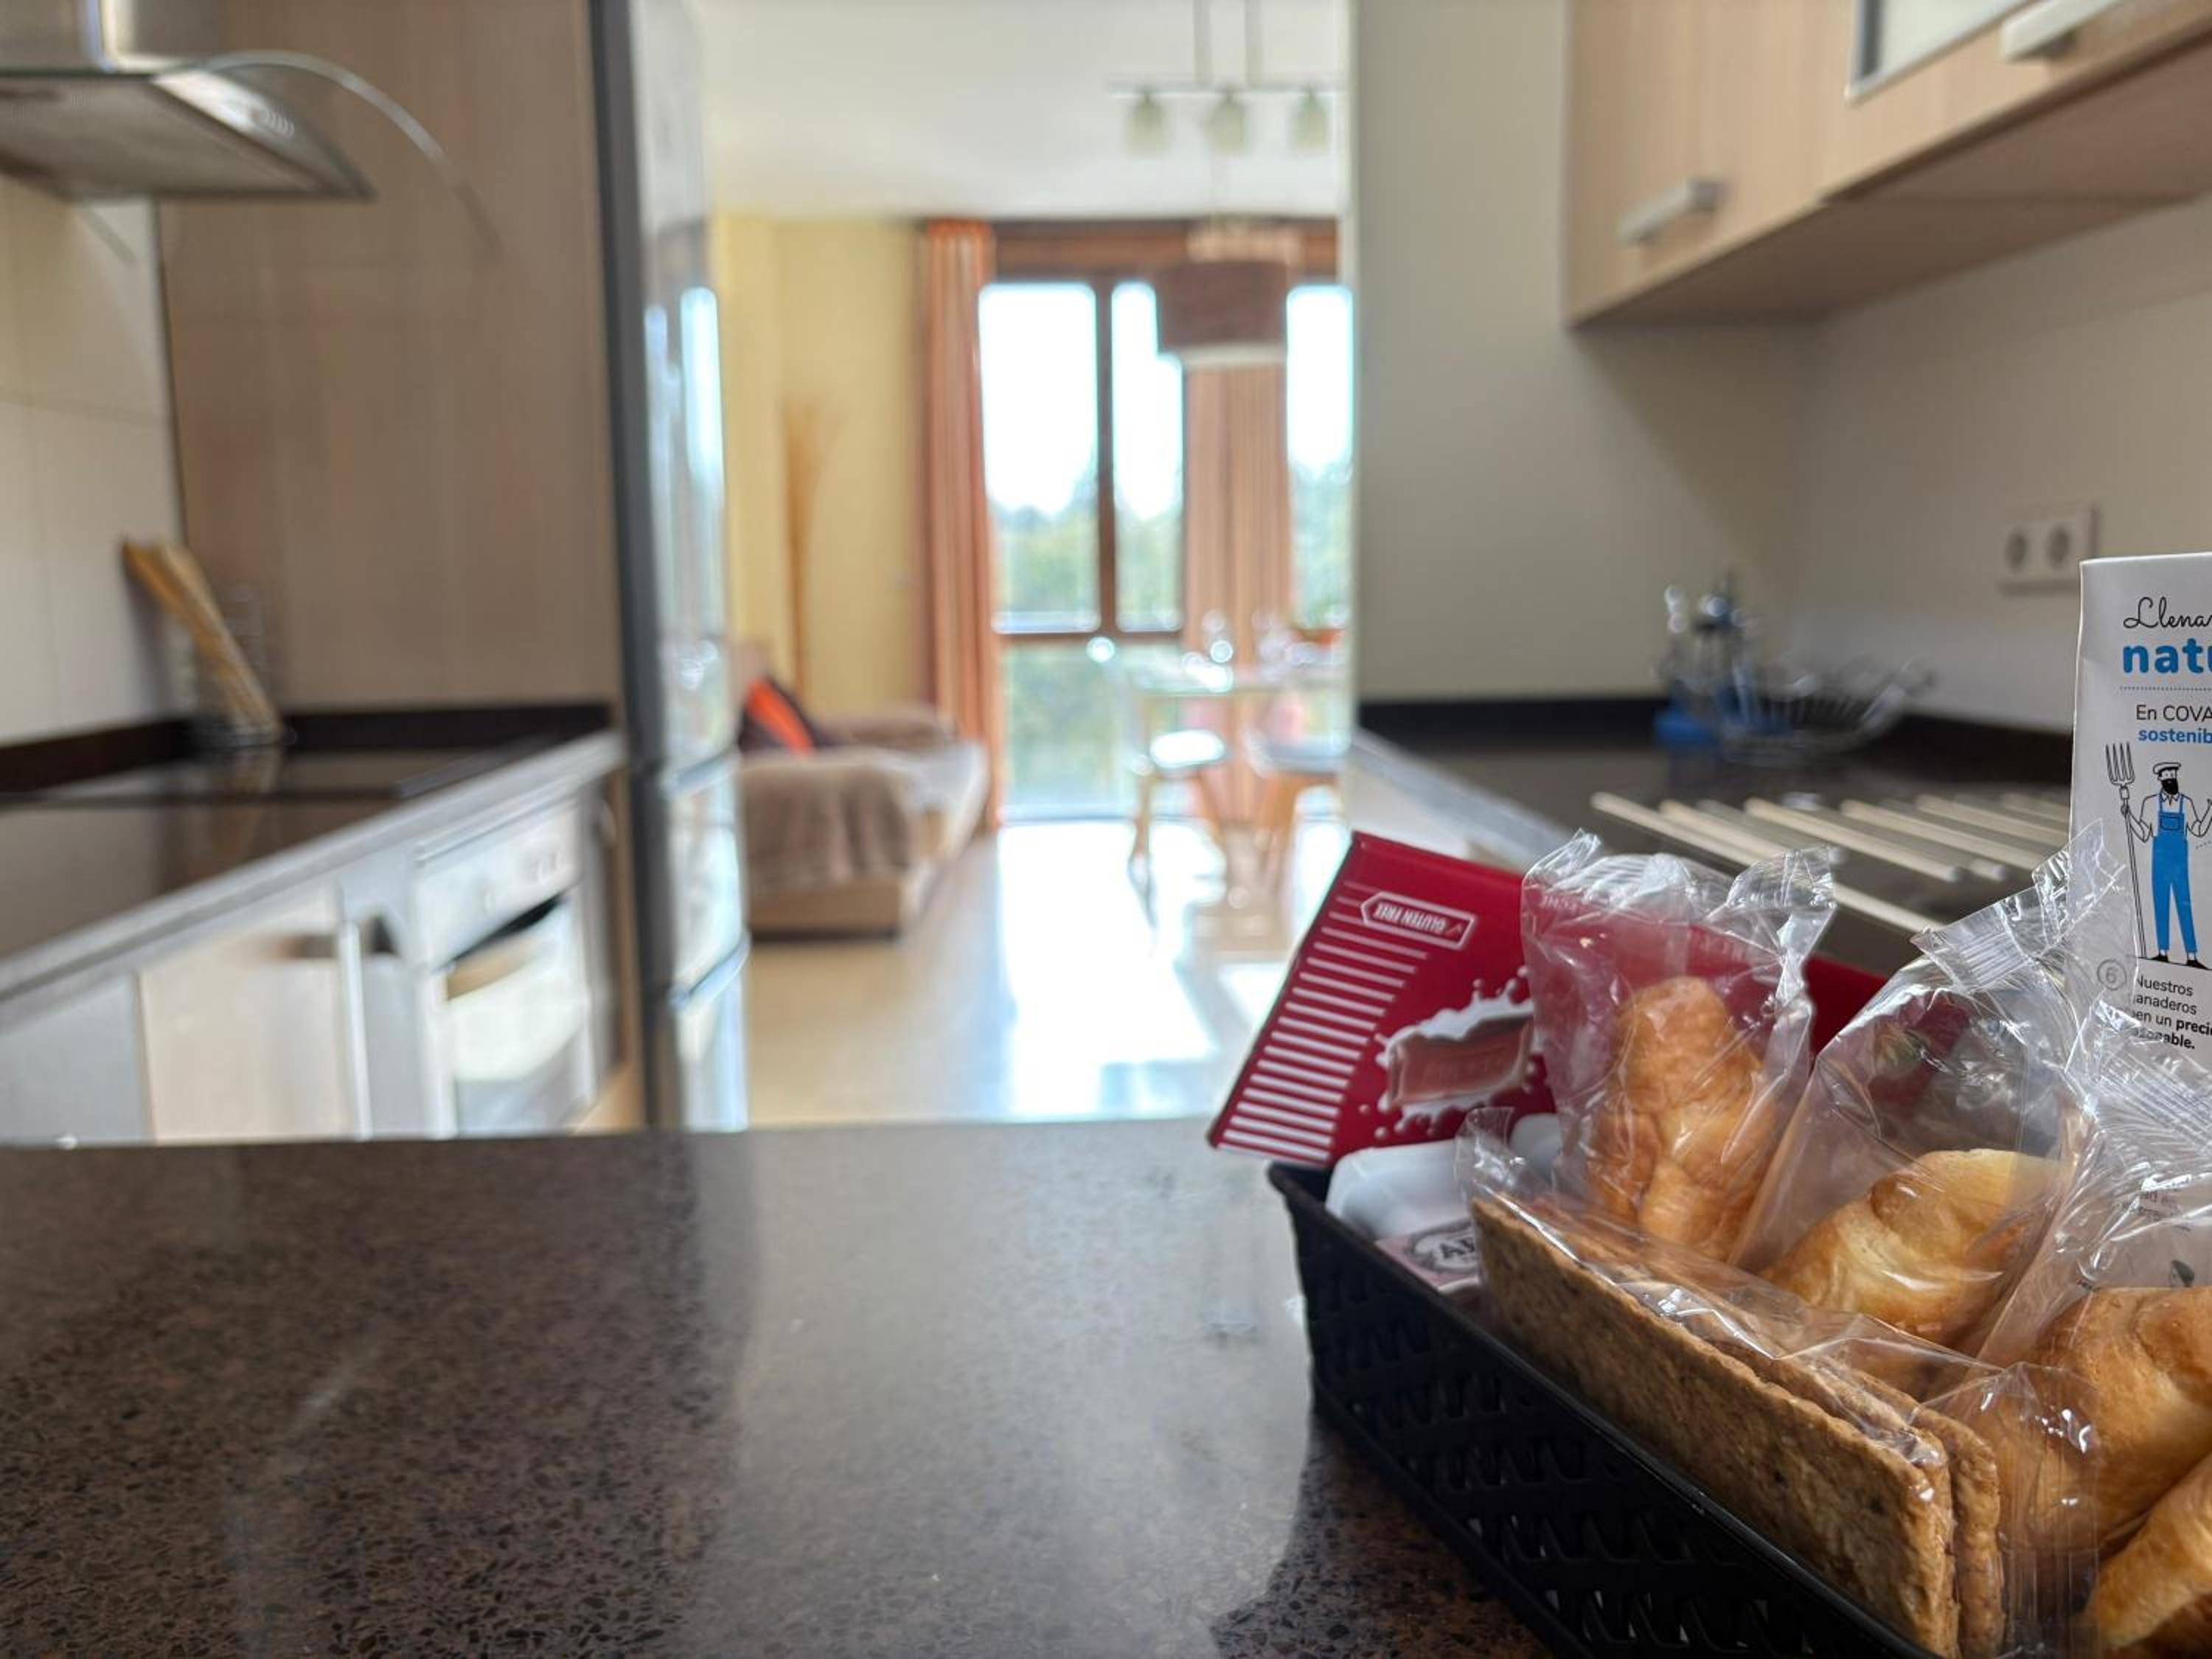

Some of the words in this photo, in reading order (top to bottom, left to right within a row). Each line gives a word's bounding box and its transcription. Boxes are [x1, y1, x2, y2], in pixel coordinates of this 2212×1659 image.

[2123, 596, 2212, 628] Llena
[2123, 638, 2212, 674] nat
[2136, 704, 2157, 720] En
[1372, 900, 1402, 922] FREE
[1401, 908, 1447, 934] GLUTEN
[2106, 967, 2118, 984] 6
[2133, 993, 2197, 1015] anaderos
[2155, 1015, 2171, 1027] un
